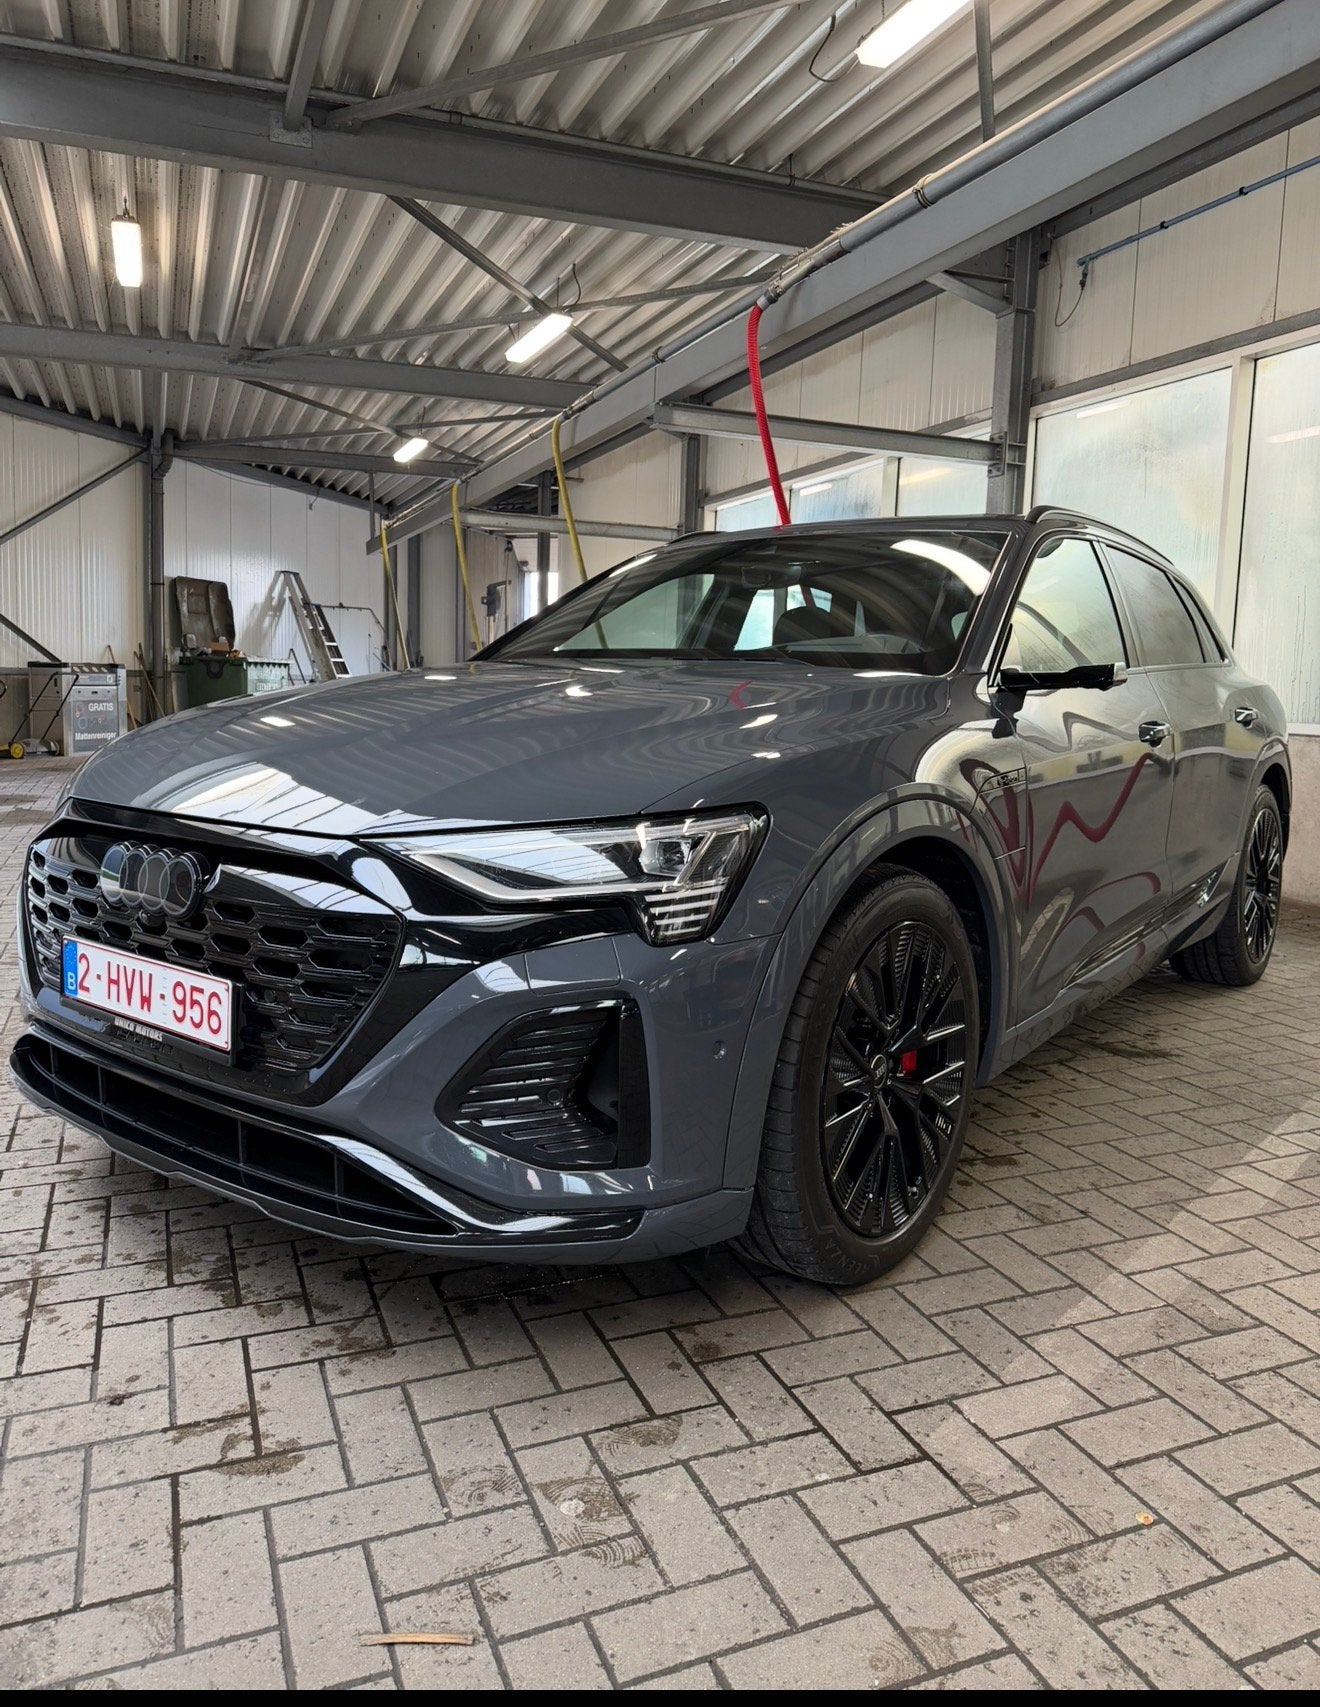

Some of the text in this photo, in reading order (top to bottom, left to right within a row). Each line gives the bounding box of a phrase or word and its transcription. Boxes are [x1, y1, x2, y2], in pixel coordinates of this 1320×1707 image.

[88, 703, 113, 711] GRATIS
[75, 732, 116, 740] Mattenreiniger
[67, 972, 75, 990] B
[78, 953, 221, 1034] 2-HVW-956
[114, 1017, 163, 1041] UNICO MOTORS
